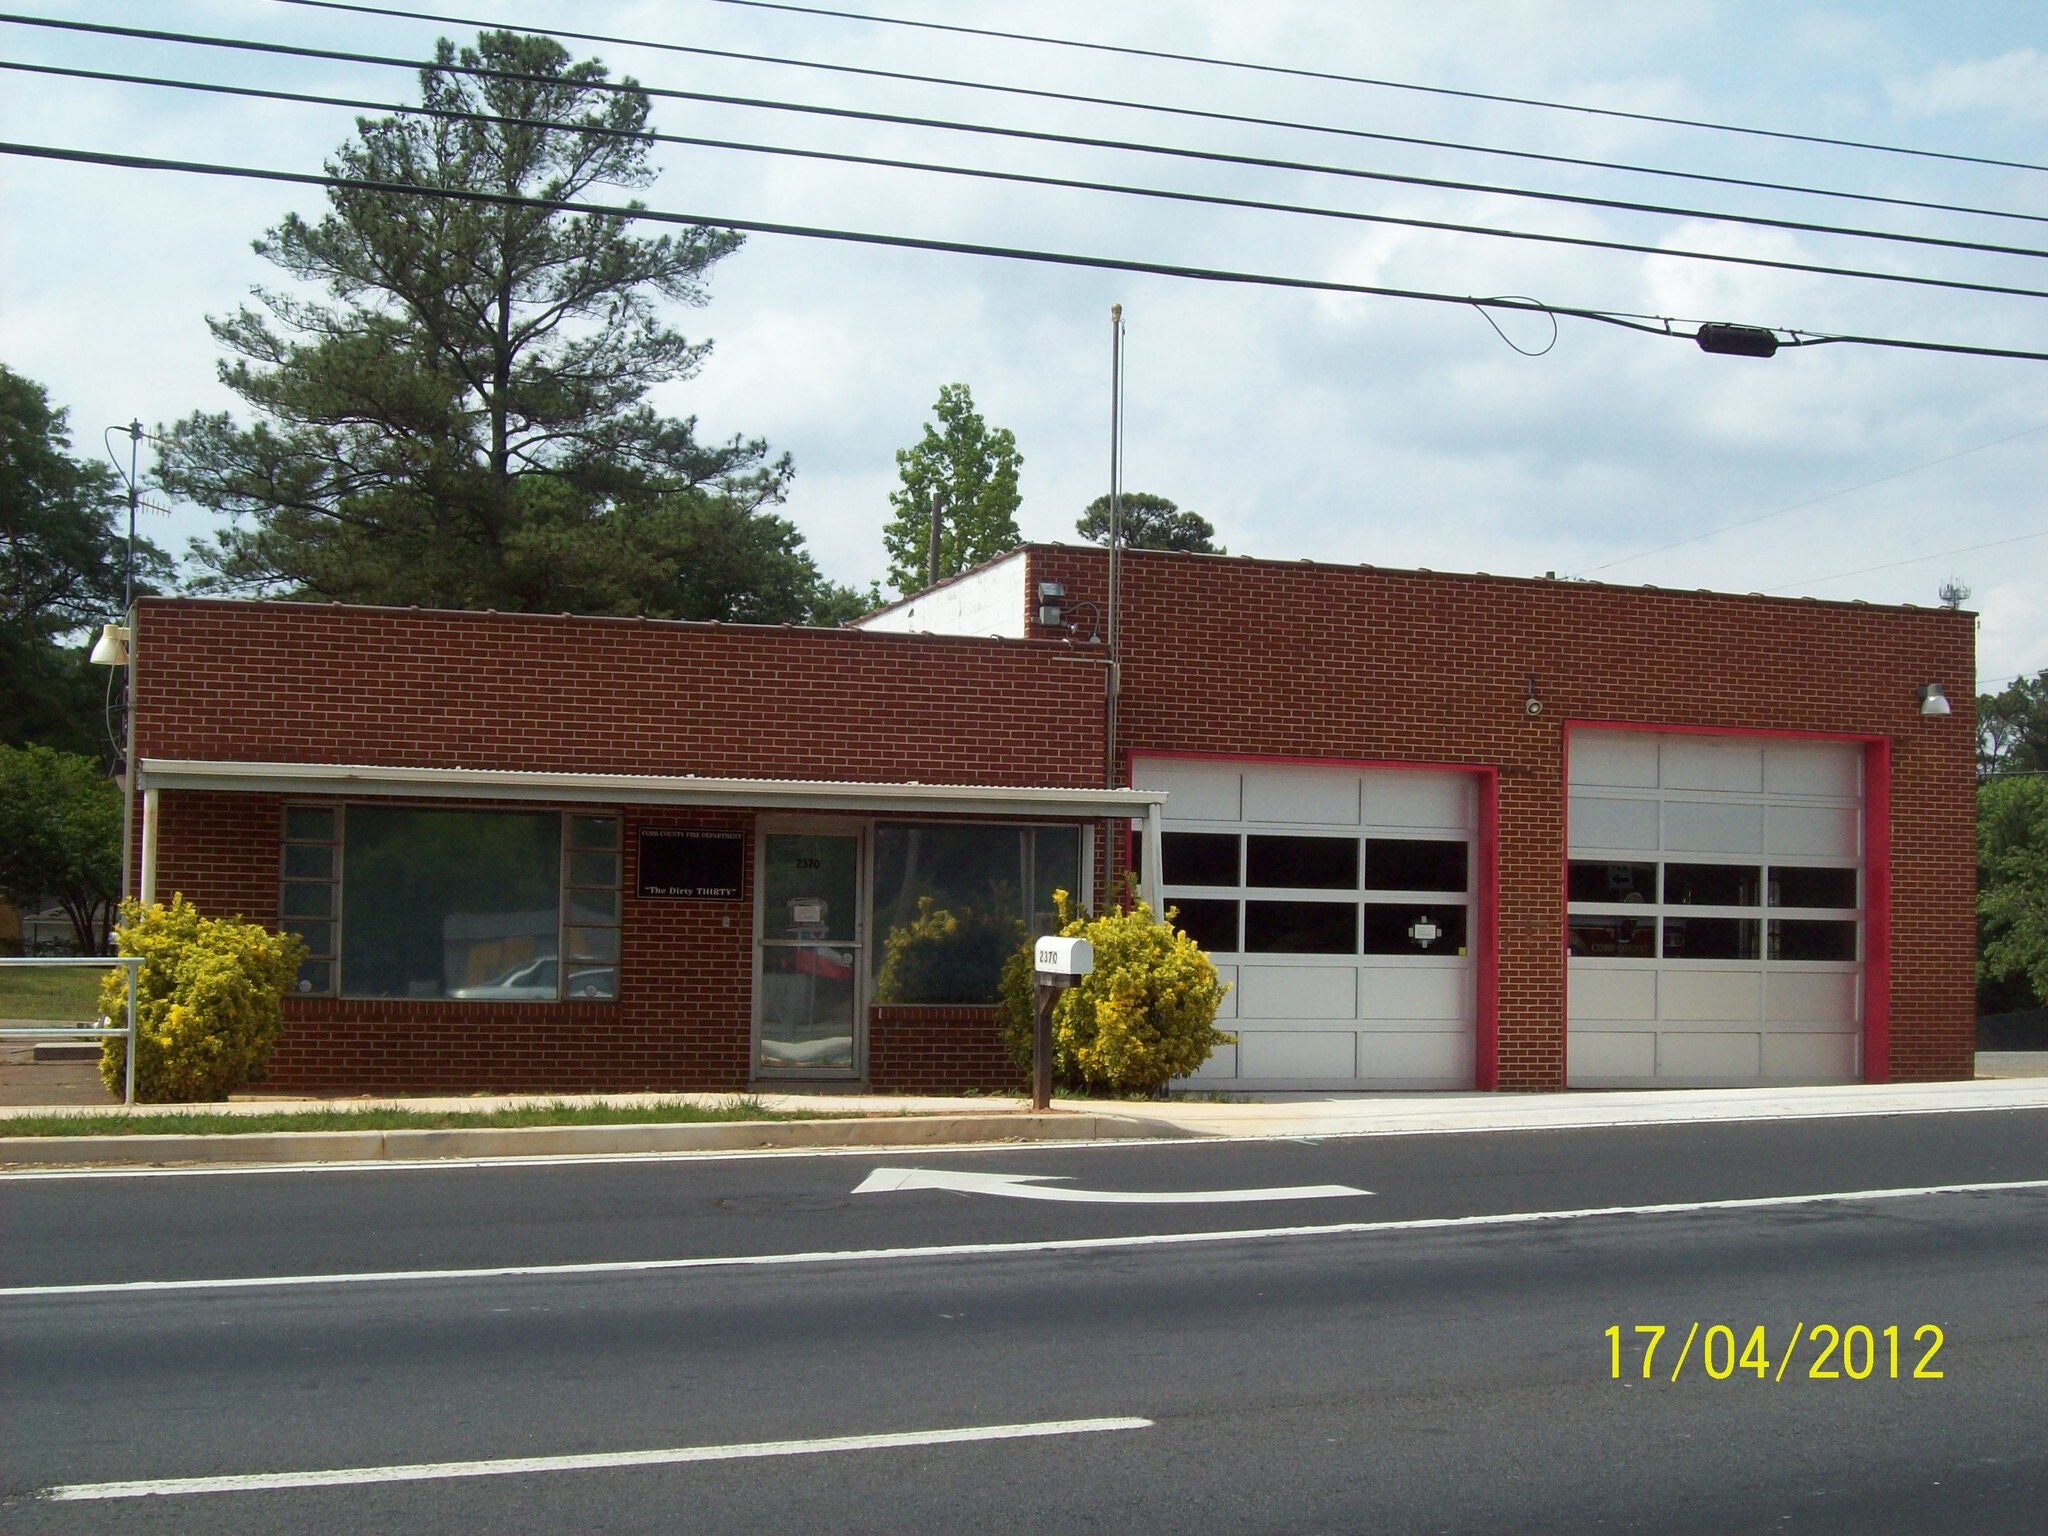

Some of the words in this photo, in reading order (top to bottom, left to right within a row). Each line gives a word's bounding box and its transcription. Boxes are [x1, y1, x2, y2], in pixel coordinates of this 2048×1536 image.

[701, 832, 742, 840] DEPARTMENT
[796, 859, 821, 869] 2370
[669, 887, 693, 897] Dirty
[1039, 950, 1058, 964] 2370
